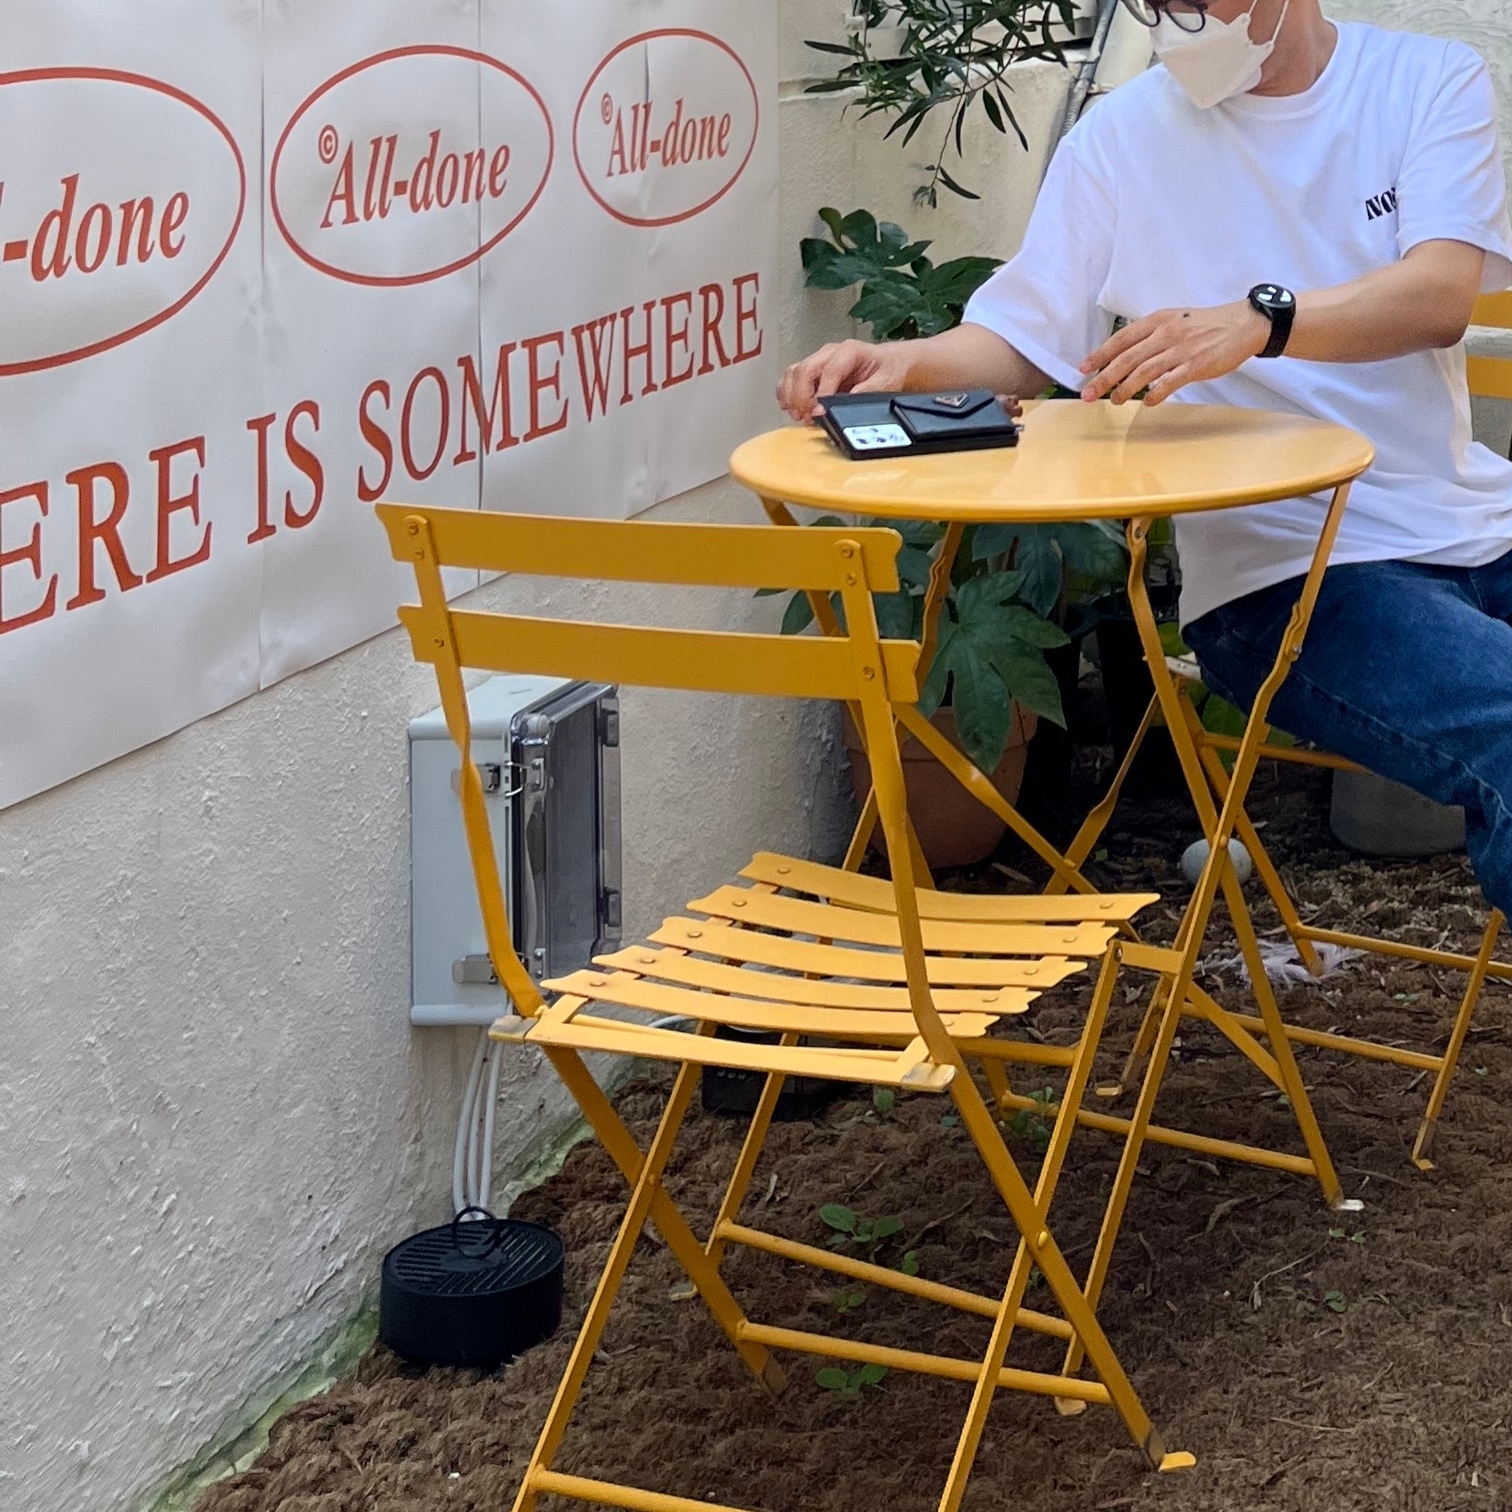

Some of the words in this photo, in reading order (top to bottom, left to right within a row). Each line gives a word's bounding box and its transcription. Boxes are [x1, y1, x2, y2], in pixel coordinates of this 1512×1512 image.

[0, 173, 190, 282] -done
[246, 399, 324, 545] IS
[357, 272, 763, 503] SOMEWHERE
